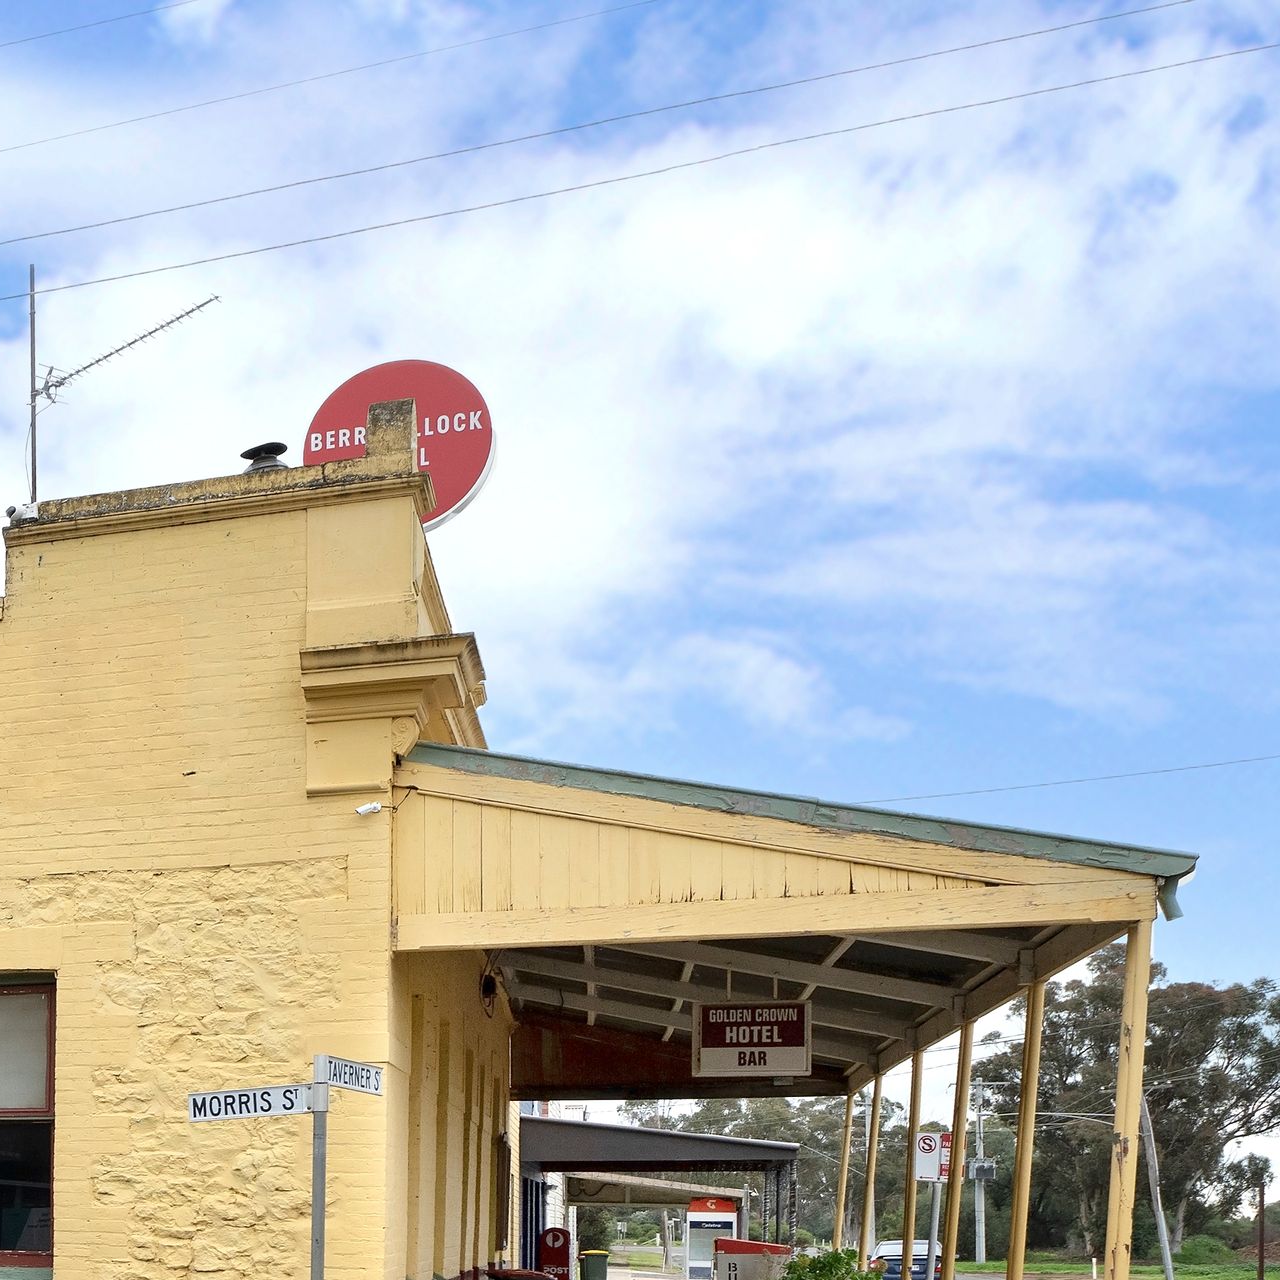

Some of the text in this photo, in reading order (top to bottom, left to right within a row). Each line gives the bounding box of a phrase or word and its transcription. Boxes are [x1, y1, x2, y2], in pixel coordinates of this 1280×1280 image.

[709, 1008, 798, 1023] GOLDEN CROWN
[725, 1025, 782, 1043] HOTEL
[737, 1051, 767, 1066] BAR
[328, 1060, 371, 1089] TAVERNER
[192, 1091, 272, 1118] MORRIS
[543, 1266, 569, 1274] POST
